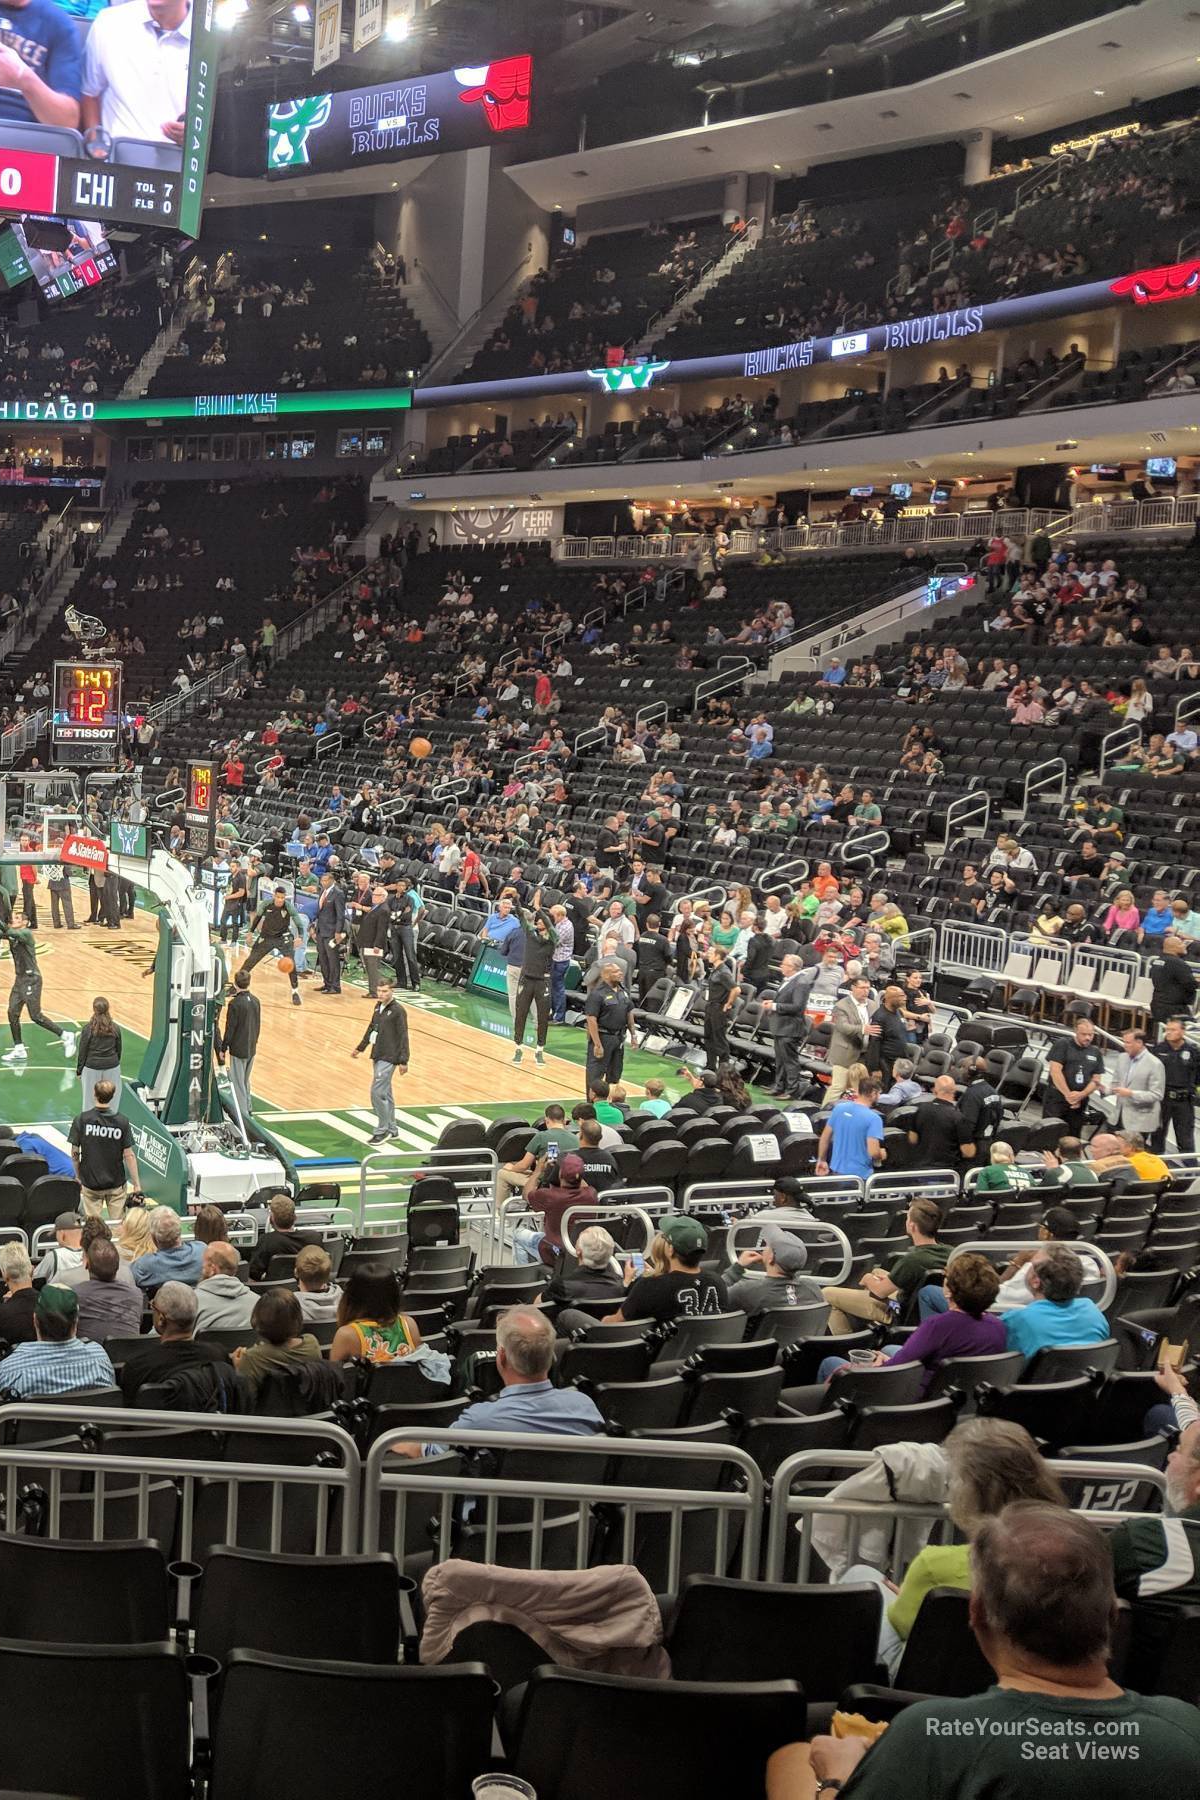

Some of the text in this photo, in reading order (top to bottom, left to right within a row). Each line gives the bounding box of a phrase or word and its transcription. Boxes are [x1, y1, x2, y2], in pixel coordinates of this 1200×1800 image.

[349, 85, 427, 128] BUCKS
[188, 60, 208, 193] CHICAGO
[386, 119, 398, 127] VS
[351, 118, 440, 155] BULLS
[0, 168, 22, 195] 0
[75, 172, 114, 207] CHI
[135, 182, 174, 197] TOL 7
[135, 198, 172, 214] FLS 0
[884, 305, 984, 351] BULLS
[842, 340, 856, 351] VS
[744, 336, 816, 377] BUCKS
[522, 510, 554, 528] FEAR
[75, 669, 112, 689] 7:47
[79, 690, 106, 722] 12
[73, 728, 116, 739] TISSOT
[193, 768, 211, 784] 7:47
[197, 786, 208, 806] 12
[189, 1029, 205, 1093] NBA
[85, 1123, 122, 1140] PHOTO
[584, 1163, 612, 1173] ECURITY
